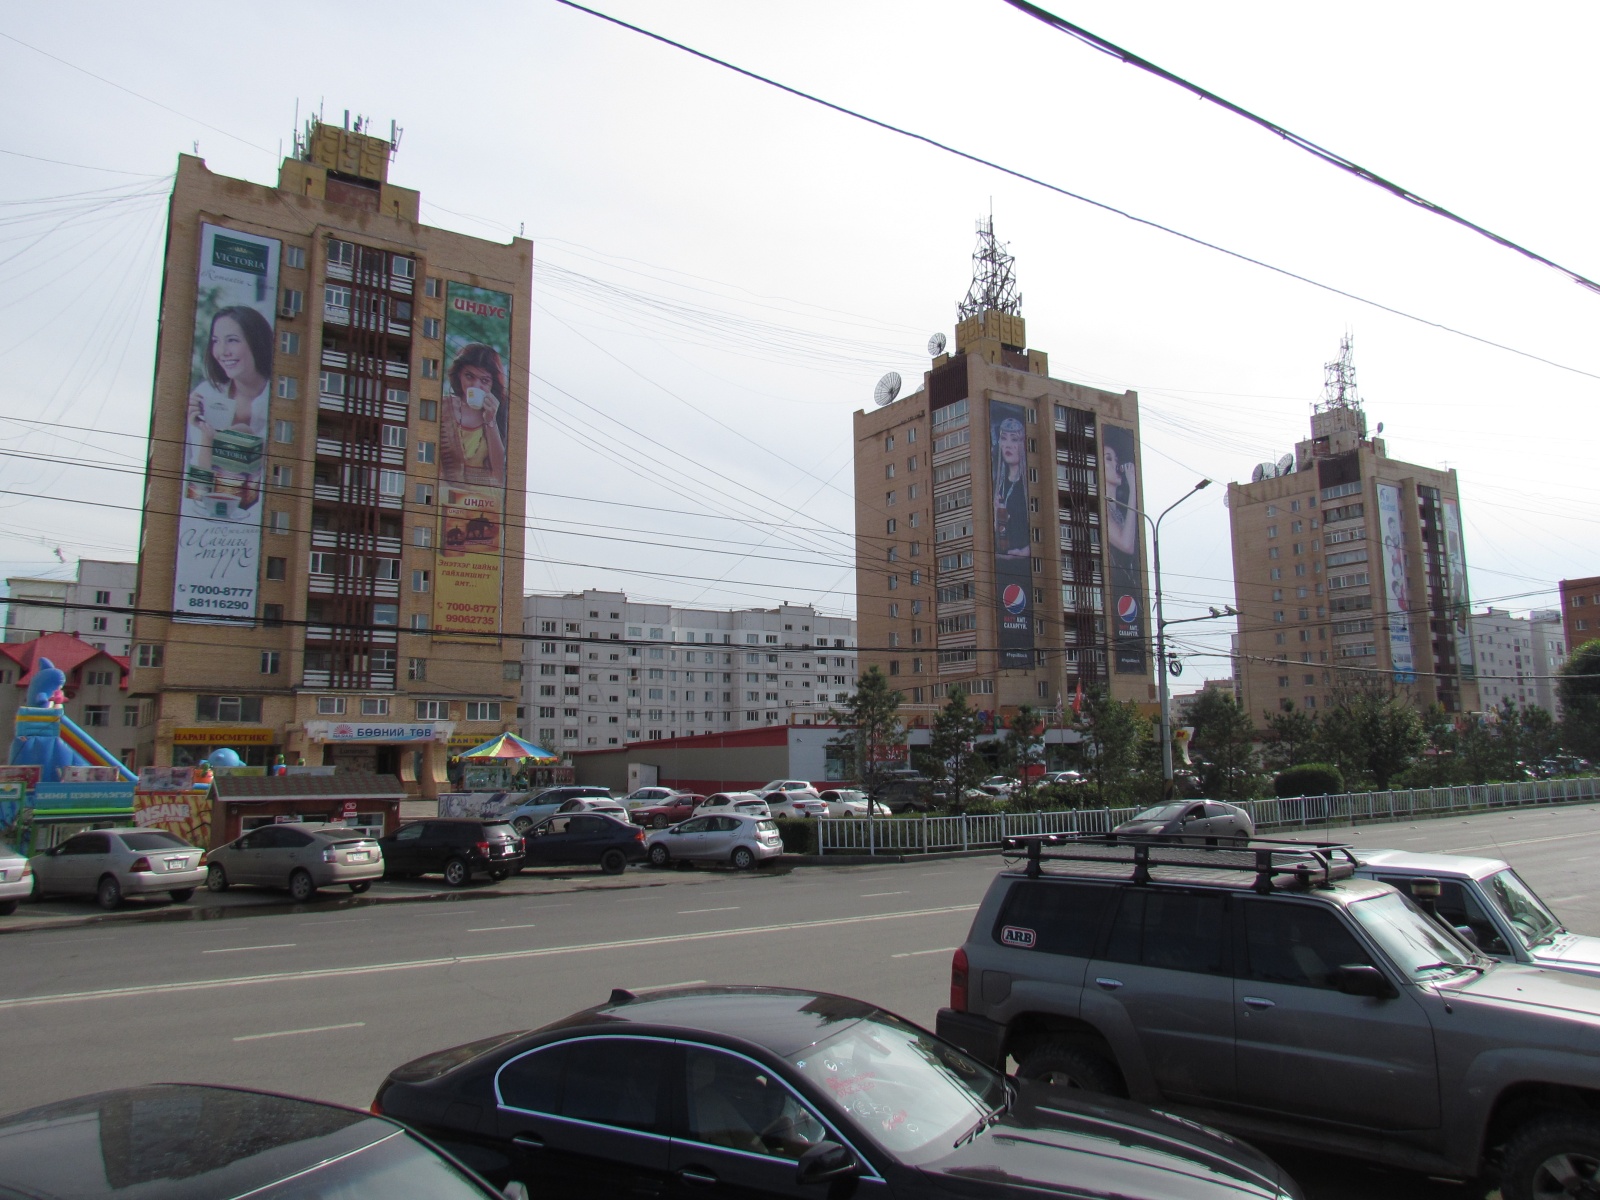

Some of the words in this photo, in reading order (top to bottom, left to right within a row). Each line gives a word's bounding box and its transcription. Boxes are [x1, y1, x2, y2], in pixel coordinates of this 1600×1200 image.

[215, 251, 265, 270] VICTORIA
[214, 447, 248, 461] VICTORIA
[190, 584, 253, 597] 7000-8777
[189, 598, 249, 610] 88116290
[446, 602, 497, 614] 7000-8777
[446, 614, 494, 625] 99062735
[174, 733, 206, 741] НАРАН
[209, 733, 270, 742] КОСМЕТИКС
[357, 728, 404, 737] БӨӨНИЙ
[410, 729, 431, 737] ТӨВ
[1005, 930, 1032, 943] ARB
